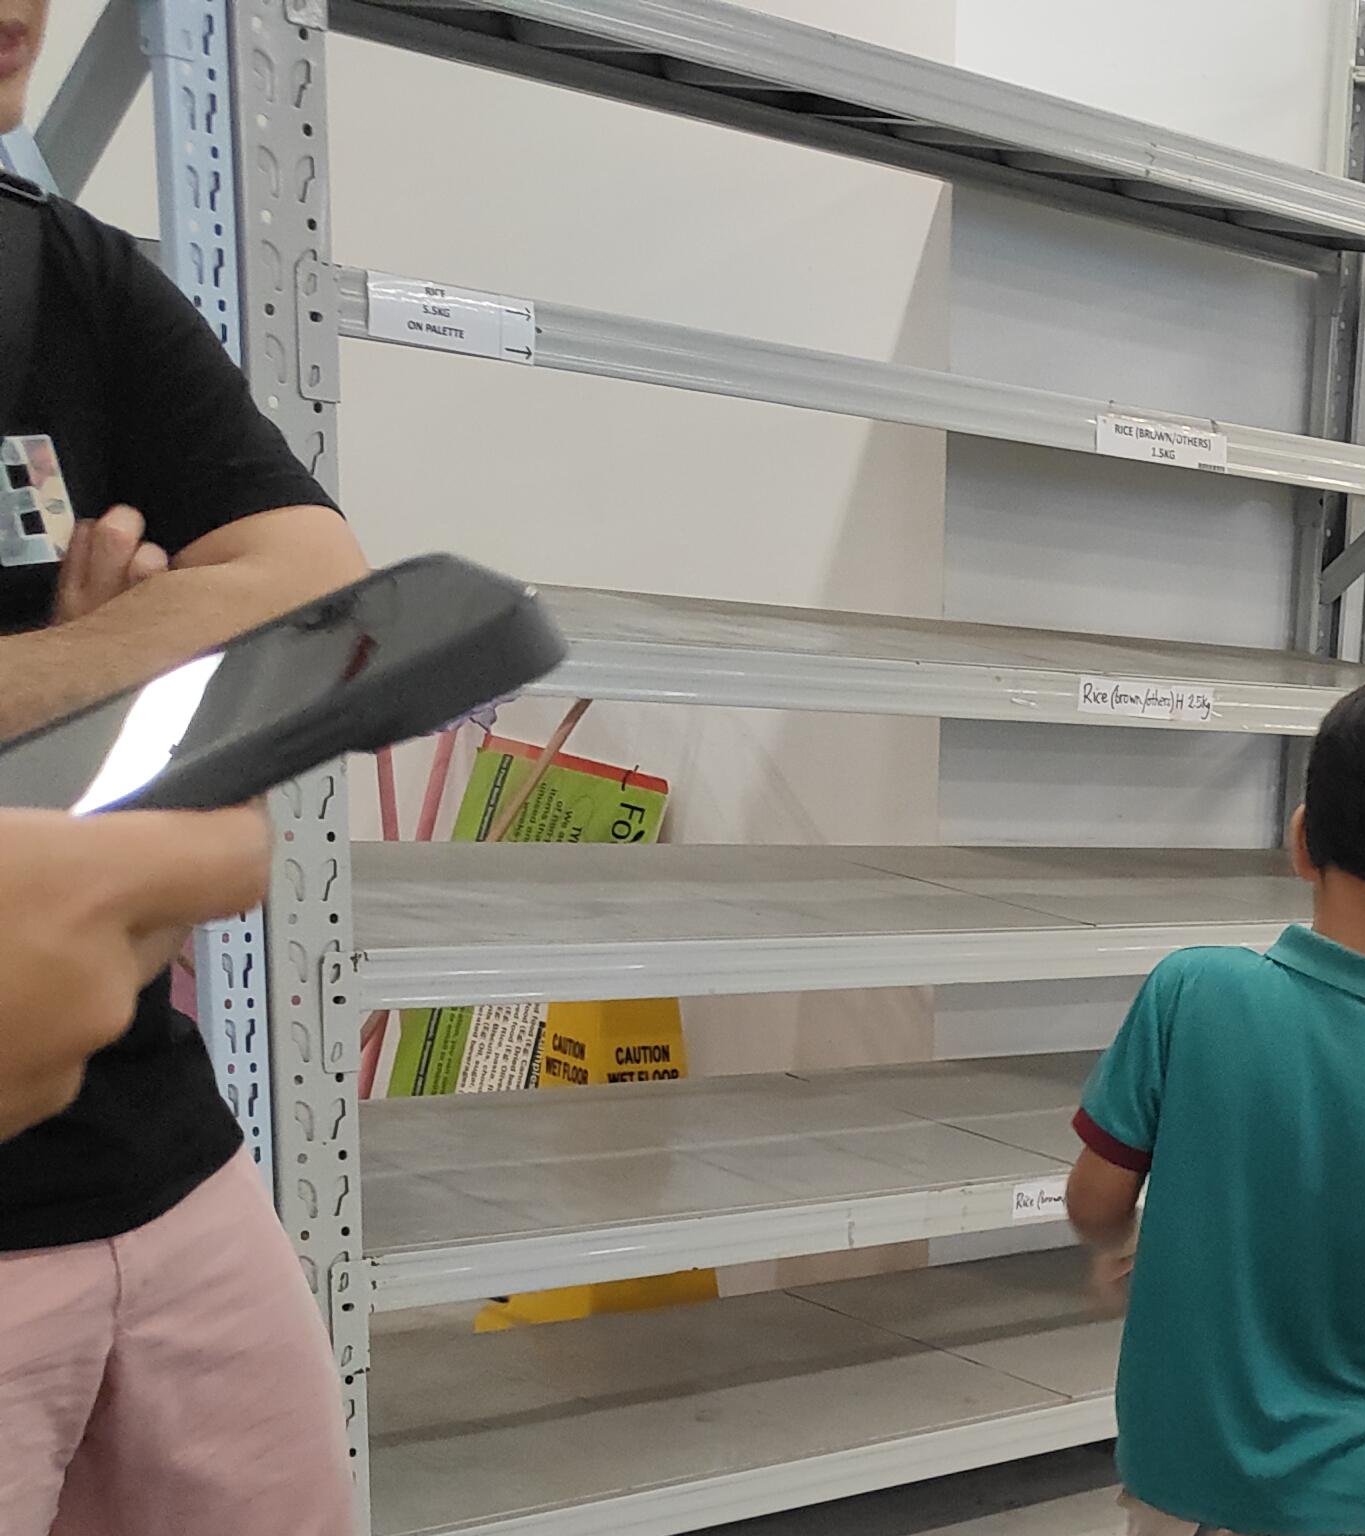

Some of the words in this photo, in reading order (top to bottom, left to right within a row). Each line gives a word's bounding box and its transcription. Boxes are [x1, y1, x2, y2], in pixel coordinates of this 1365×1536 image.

[407, 320, 423, 331] ON
[425, 324, 465, 339] PALETTE
[1114, 424, 1133, 436] RICE
[1083, 682, 1108, 704] Rice
[552, 1033, 586, 1061] CAUTION
[615, 1044, 671, 1065] CAUTION
[546, 1056, 561, 1077] WET
[562, 1062, 588, 1085] FLOOR
